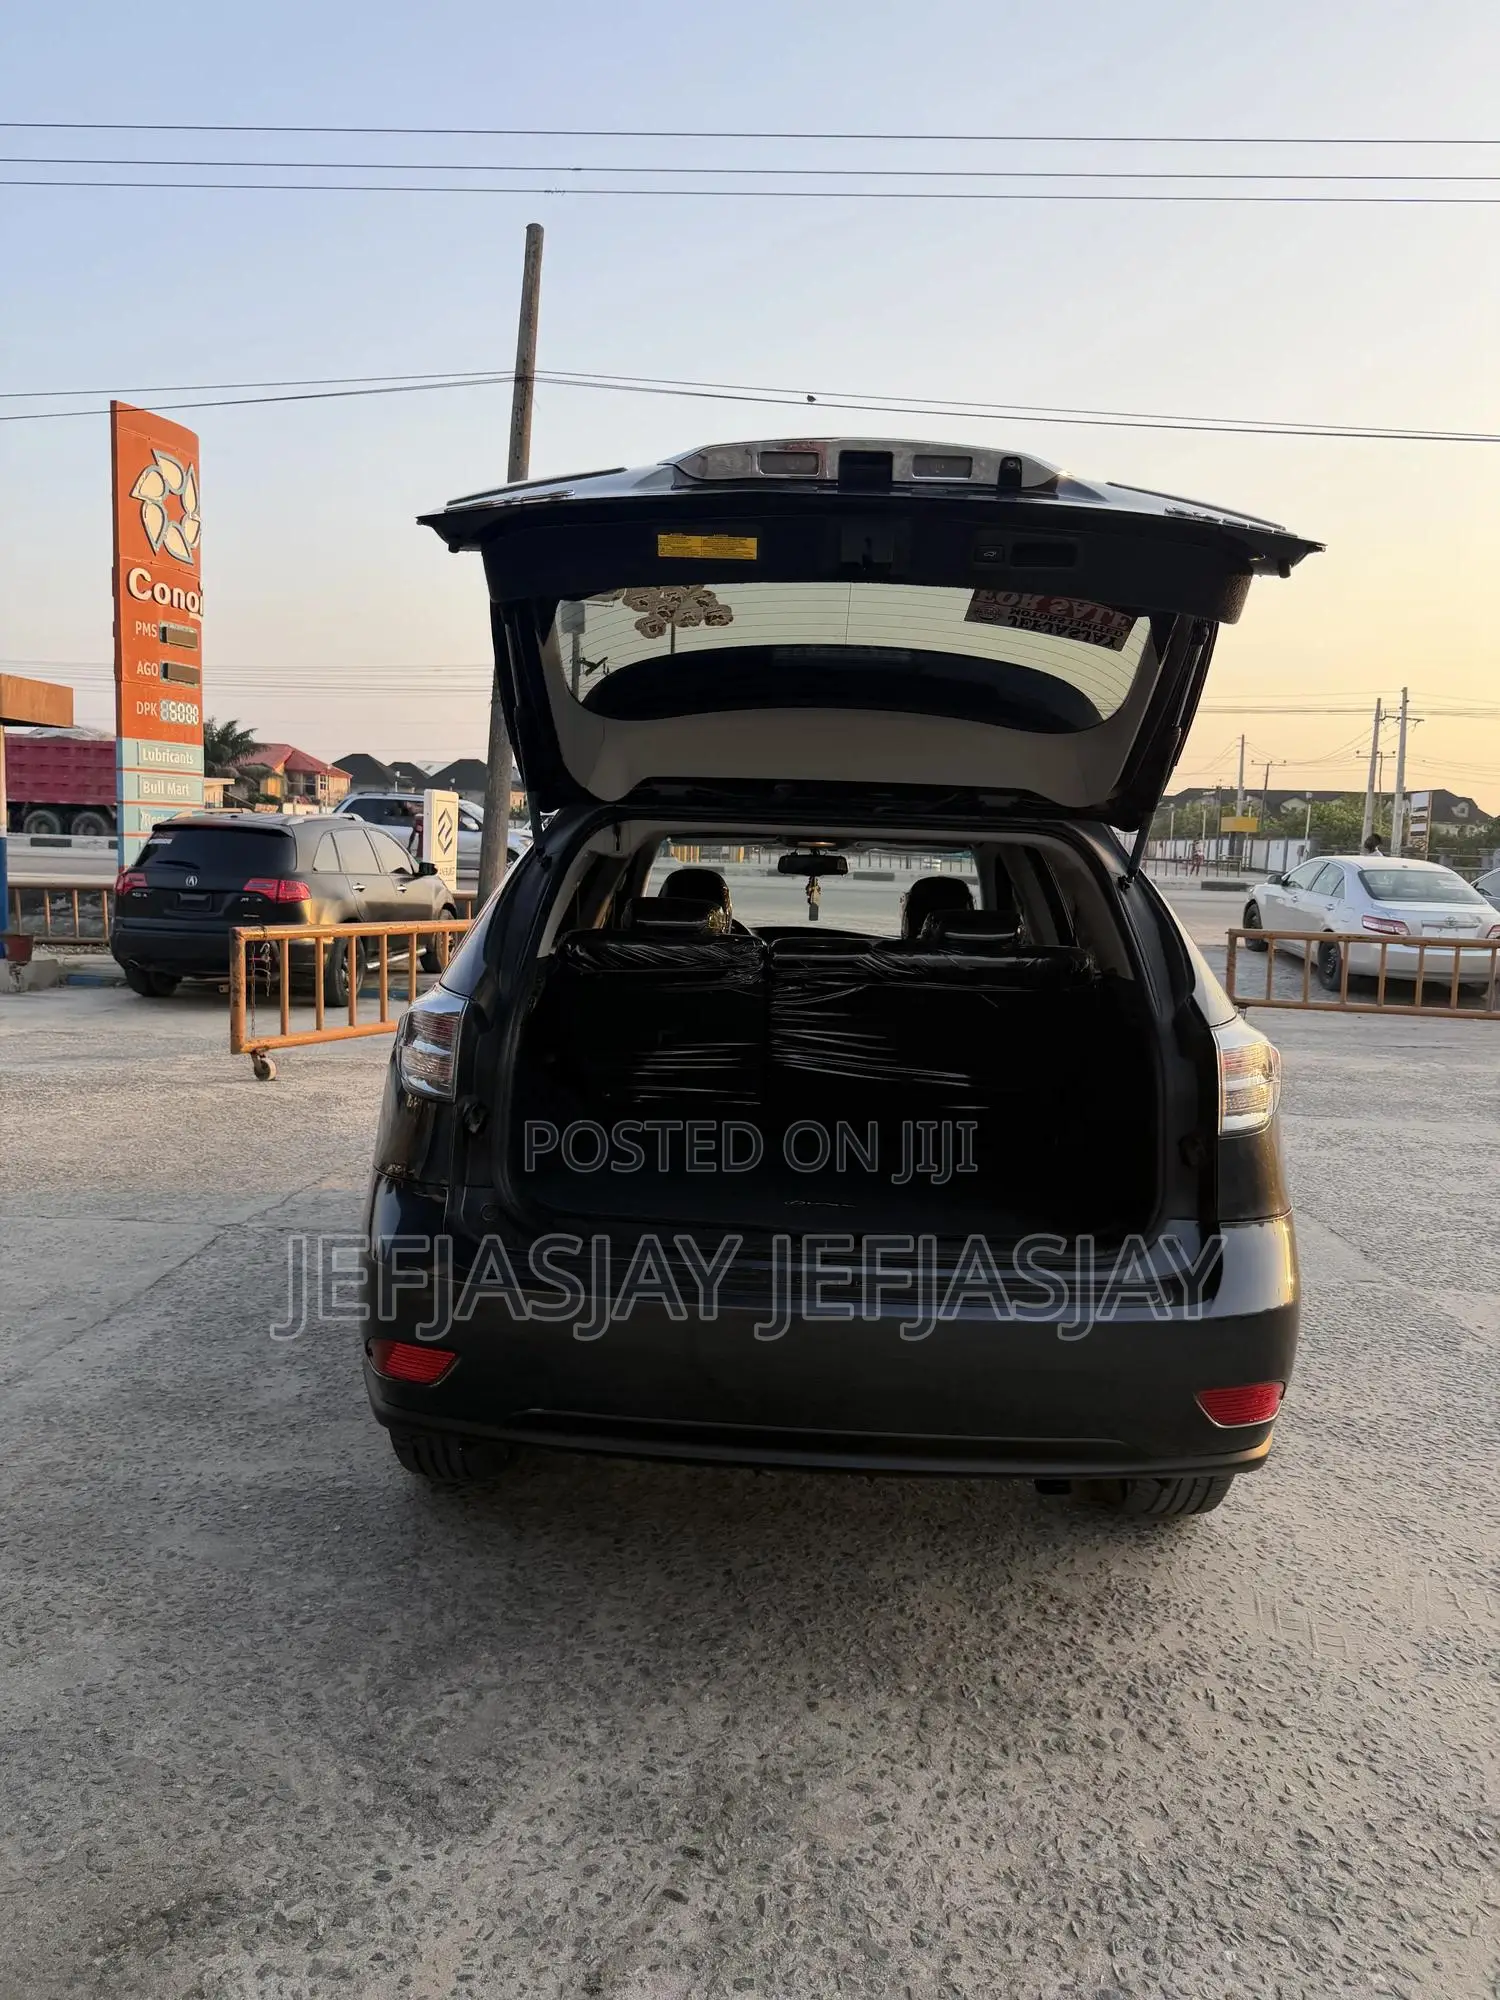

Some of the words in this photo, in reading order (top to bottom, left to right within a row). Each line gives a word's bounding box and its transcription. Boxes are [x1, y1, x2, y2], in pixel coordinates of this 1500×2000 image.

[135, 620, 158, 638] PMS
[136, 661, 159, 677] AGO
[136, 701, 158, 717] DPK
[142, 748, 194, 765] Lubricants
[143, 781, 165, 794] Bull
[167, 782, 190, 796] Mart
